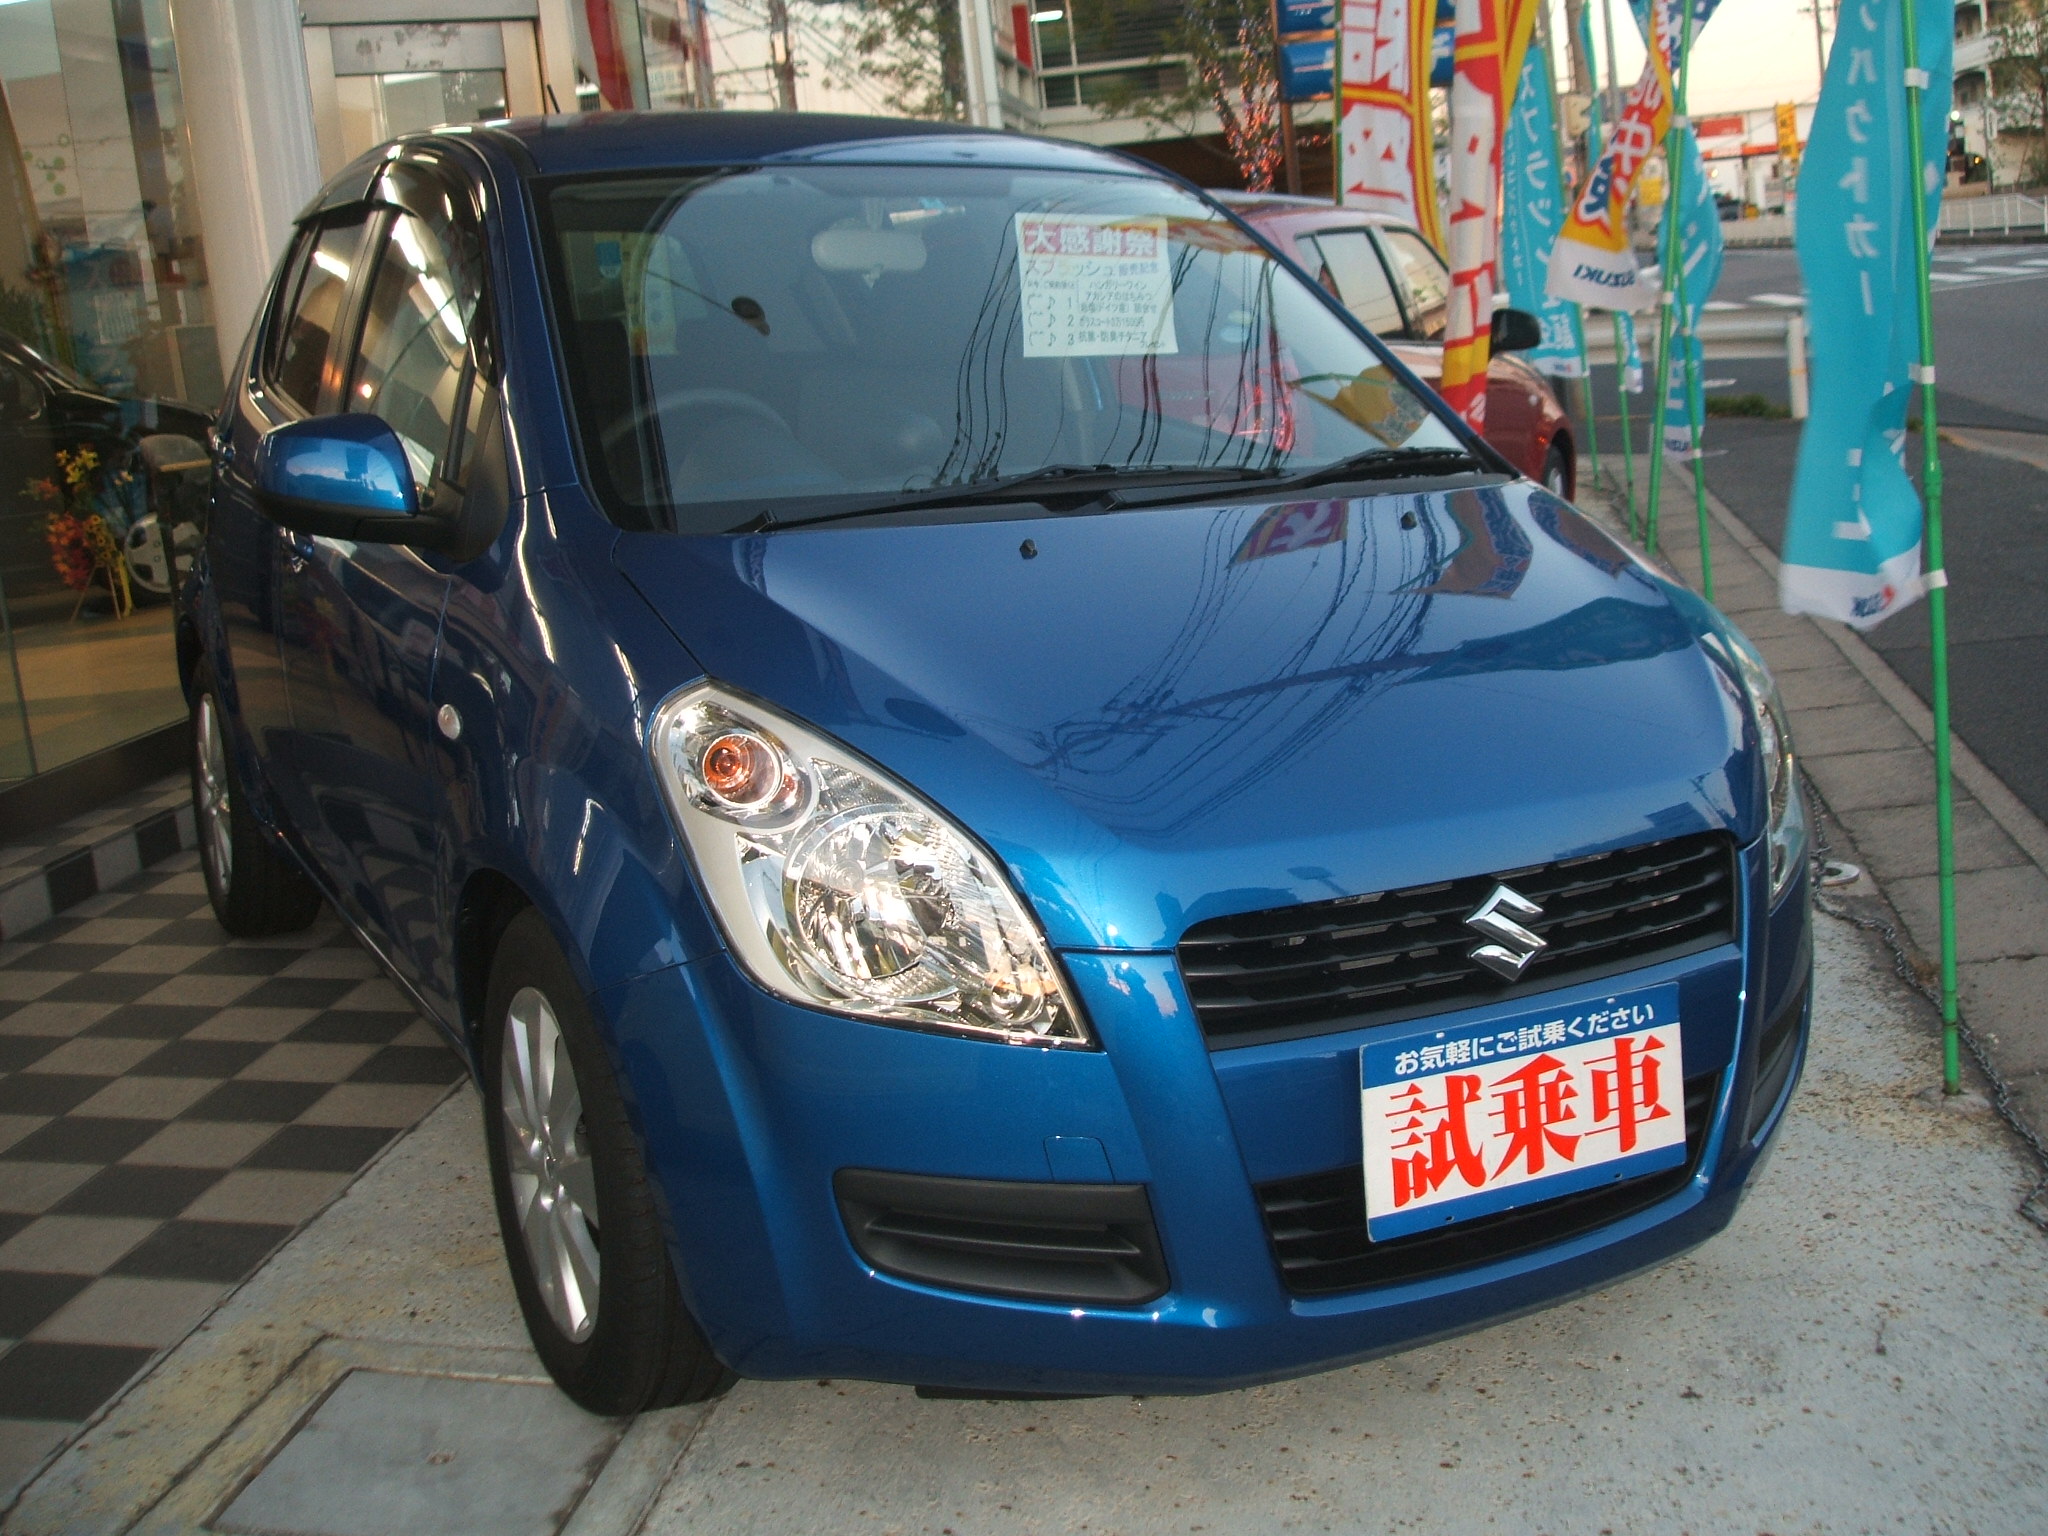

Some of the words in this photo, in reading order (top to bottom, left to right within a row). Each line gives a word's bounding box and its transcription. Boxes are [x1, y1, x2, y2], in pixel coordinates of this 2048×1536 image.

[1025, 225, 1156, 256] 大感謝祭
[1394, 1003, 1655, 1076] お気軽にご試乗ください
[1384, 1035, 1673, 1208] 試乗車
